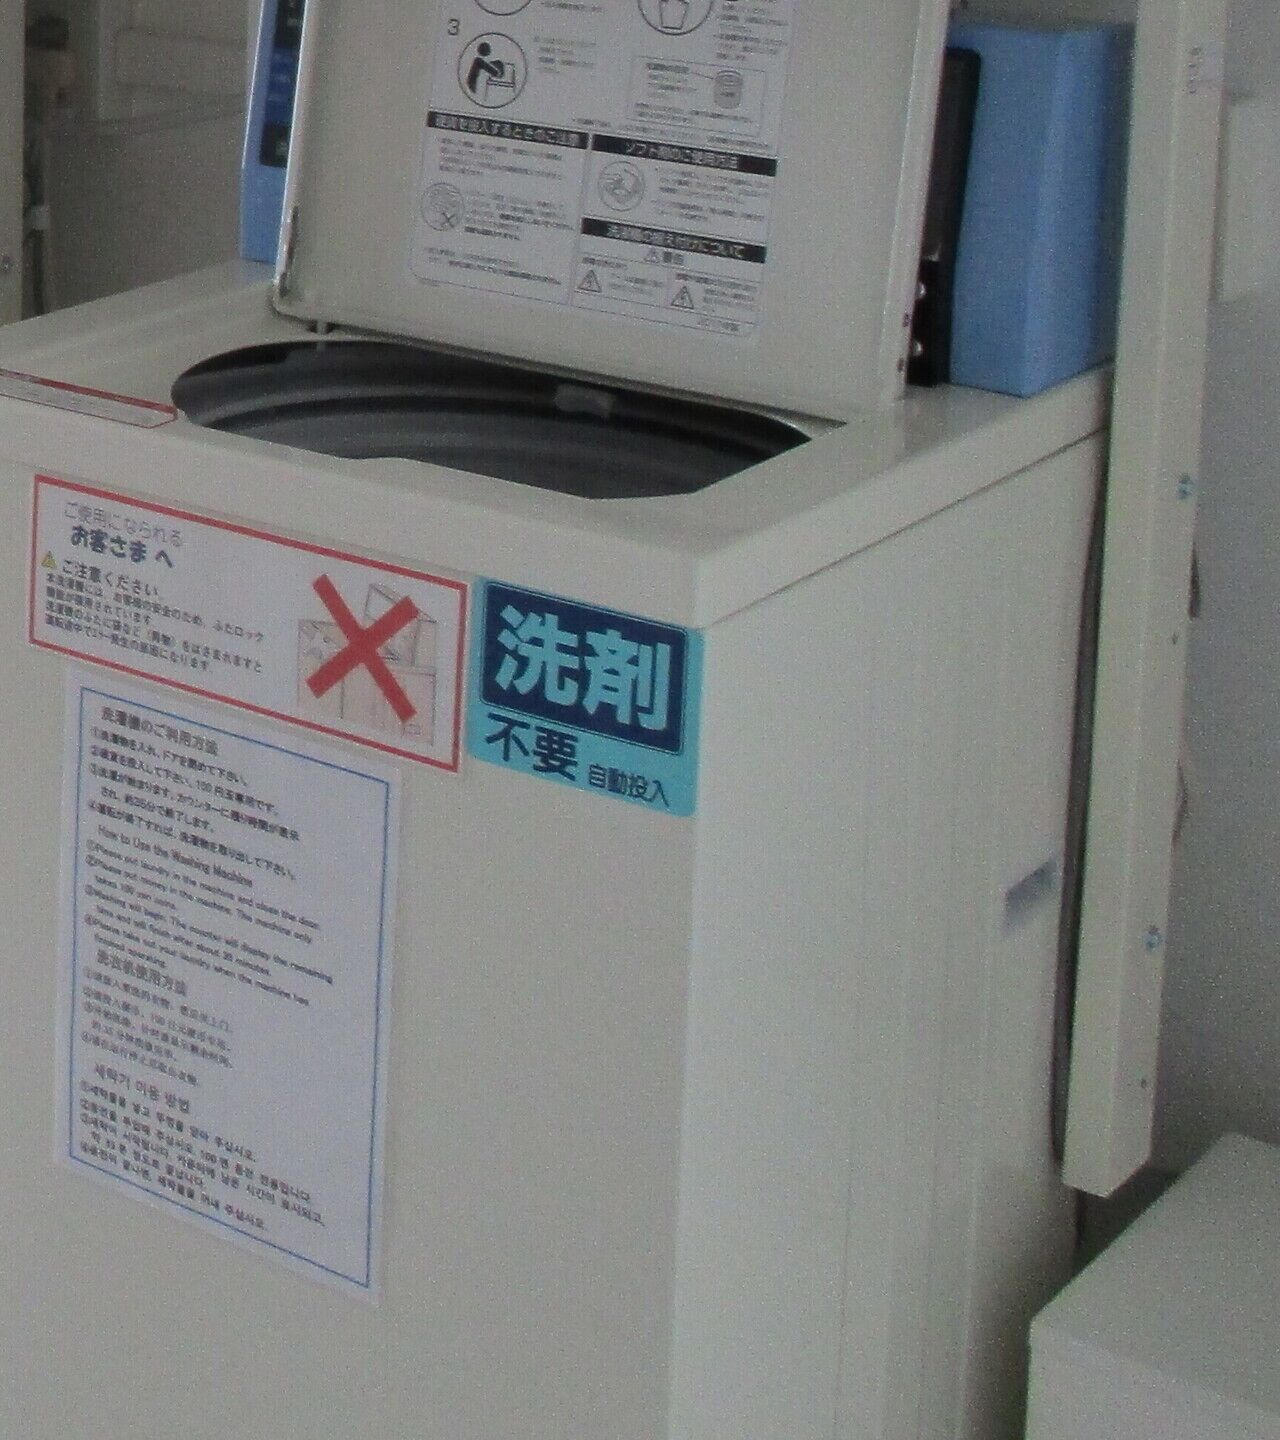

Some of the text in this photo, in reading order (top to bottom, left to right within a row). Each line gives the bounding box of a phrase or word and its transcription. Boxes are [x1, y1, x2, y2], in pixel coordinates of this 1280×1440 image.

[448, 18, 460, 36] 3
[63, 498, 184, 549] ご使用になられる
[493, 604, 672, 732] 洗剤
[101, 704, 219, 757] 洗濯機のご利用方法
[485, 711, 670, 808] 不要 自動投入
[97, 825, 253, 888] How to Use the Washing Machine
